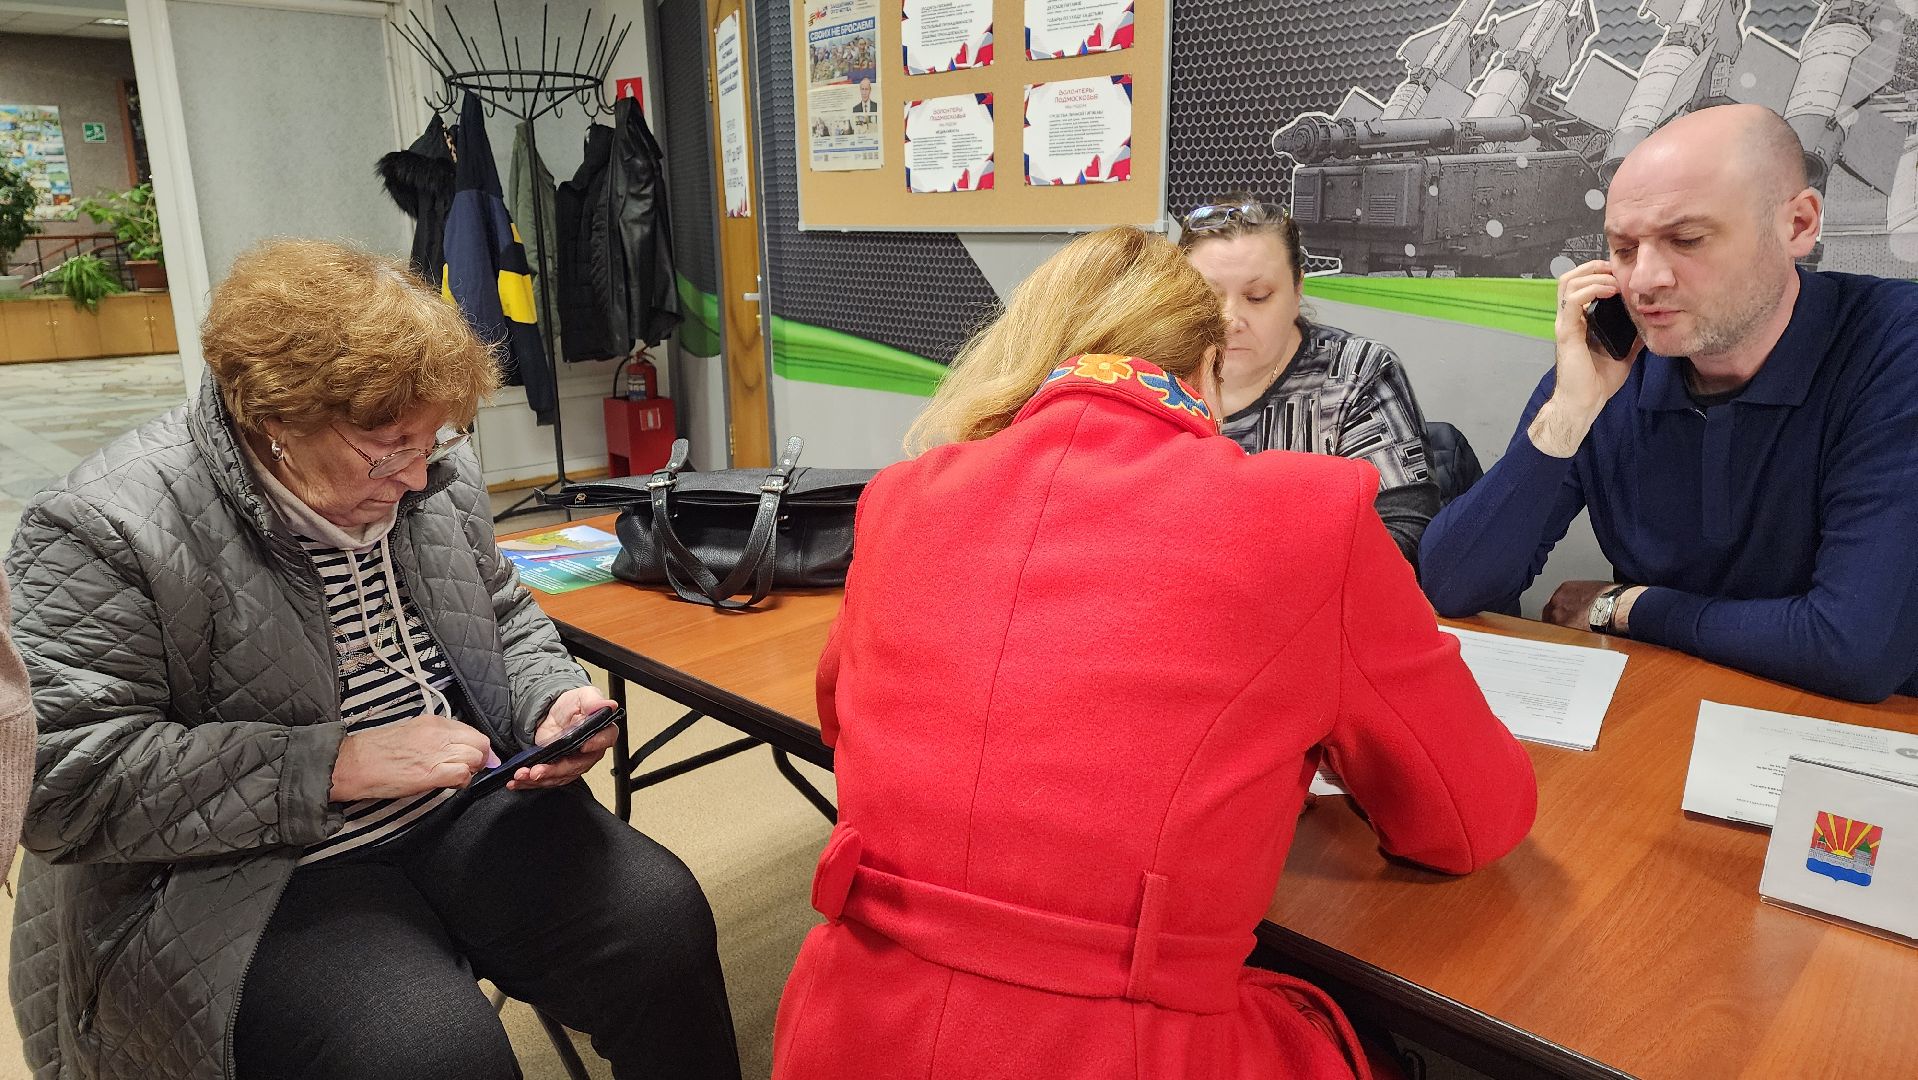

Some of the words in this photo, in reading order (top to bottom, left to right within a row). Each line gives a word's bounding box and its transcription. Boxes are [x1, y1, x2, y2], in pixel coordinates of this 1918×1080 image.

[810, 27, 831, 41] СВОИХ
[831, 25, 841, 37] НЕ
[840, 19, 874, 35] БРОСАЕМ!
[1058, 87, 1095, 96] ВОЛОНТЕРЫ
[1054, 93, 1099, 103] ПОДМОСКОВЬЯ
[933, 106, 963, 115] ВОЛОНТЕРЫ
[929, 113, 967, 121] ПОДМОСКОВЬЯ
